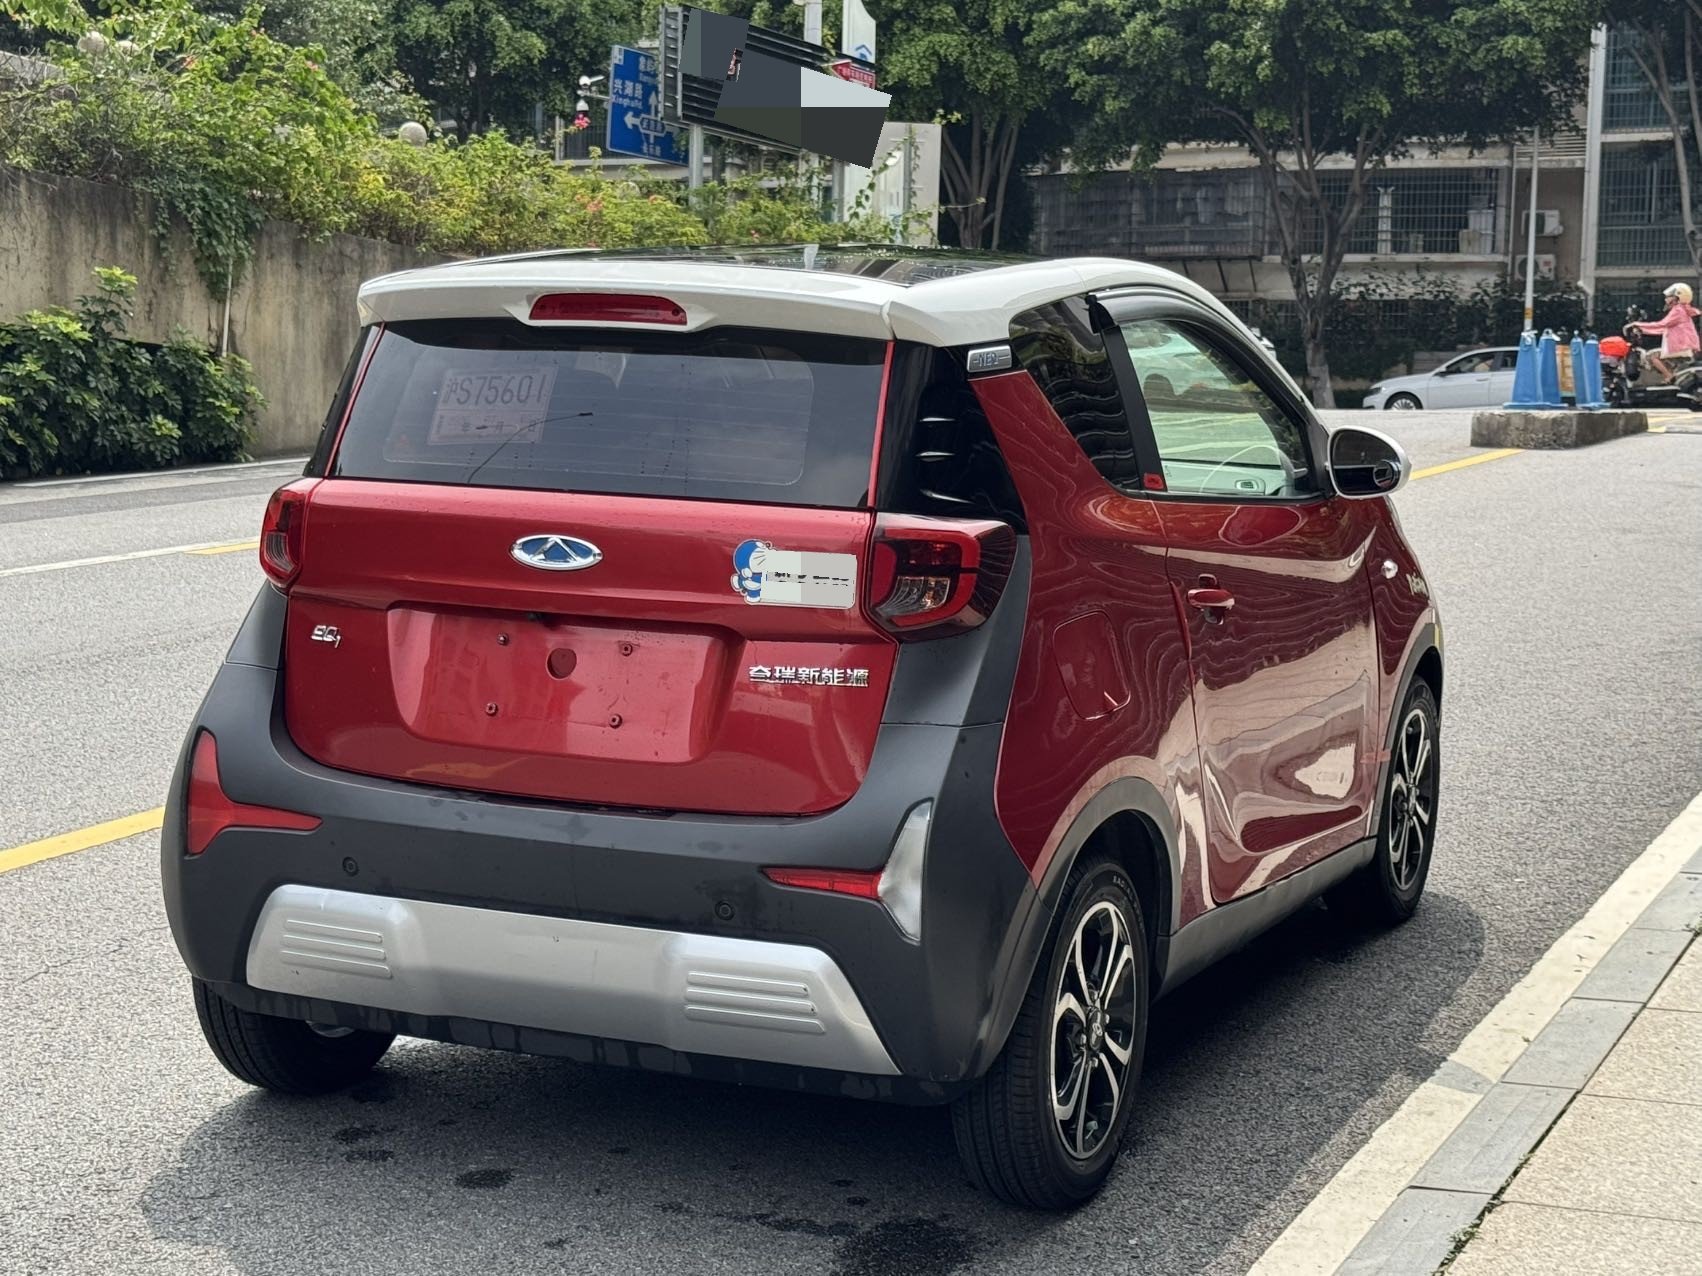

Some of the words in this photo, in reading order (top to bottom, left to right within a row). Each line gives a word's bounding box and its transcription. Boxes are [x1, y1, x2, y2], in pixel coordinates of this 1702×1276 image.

[749, 665, 869, 687] 奇瑞新能源
